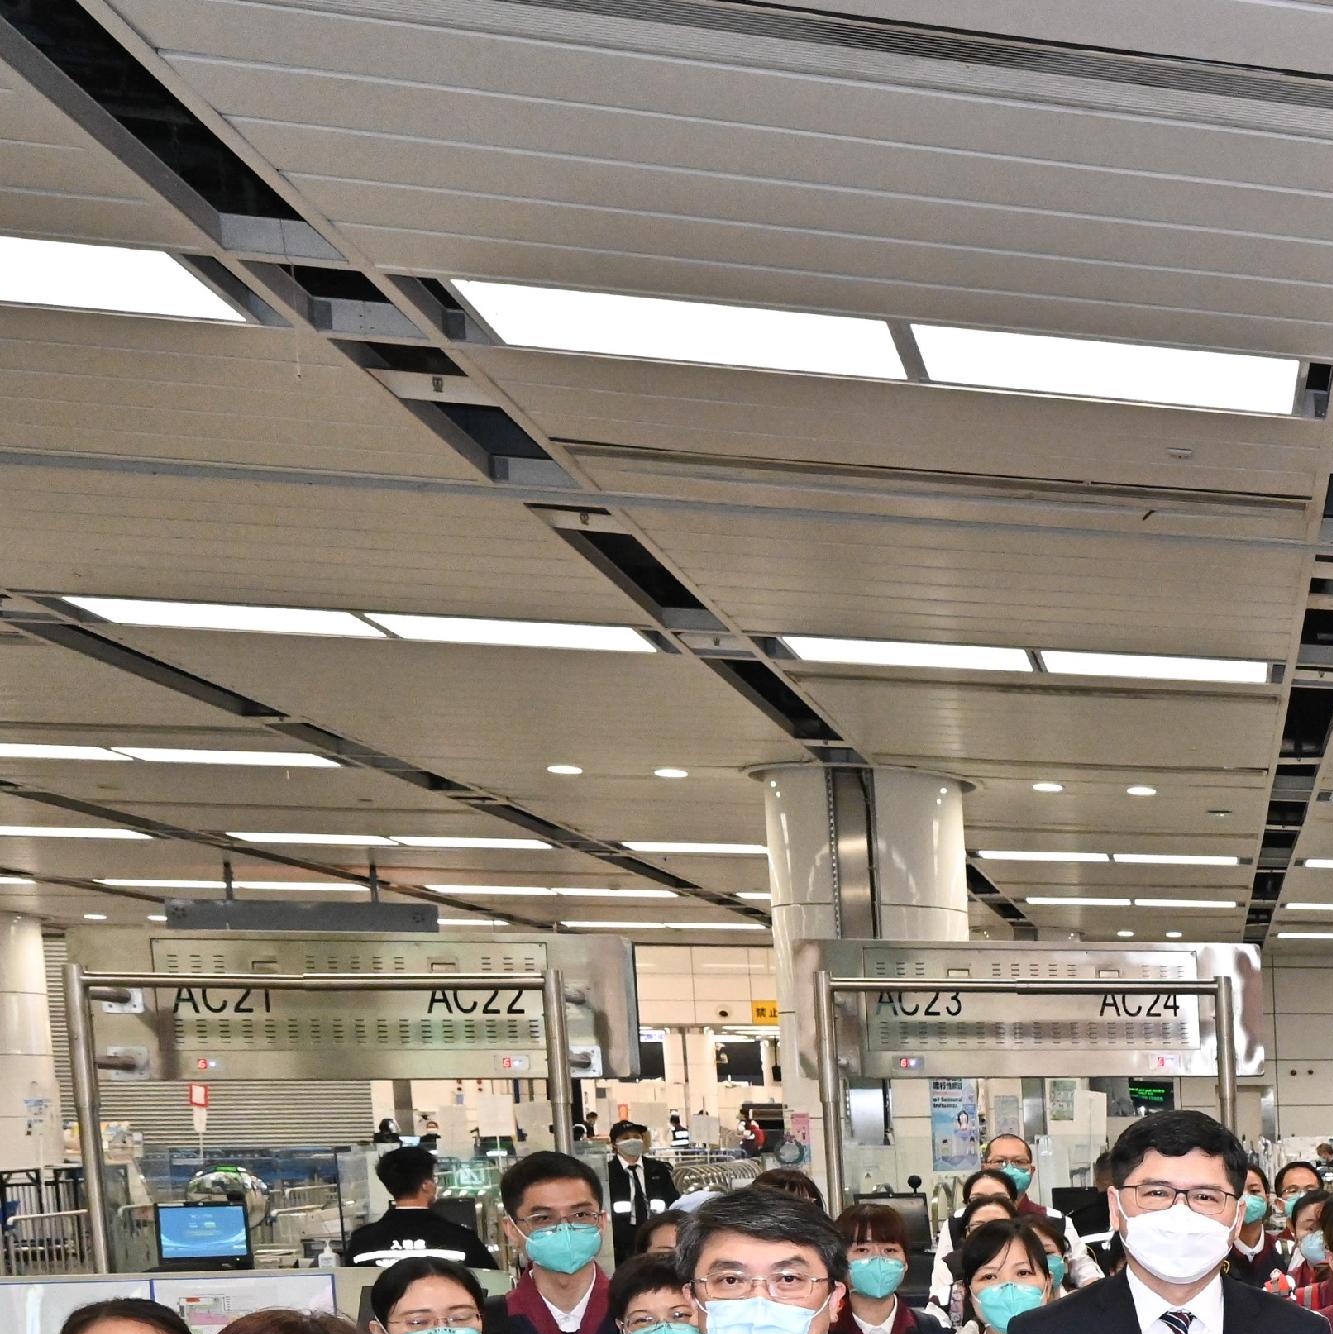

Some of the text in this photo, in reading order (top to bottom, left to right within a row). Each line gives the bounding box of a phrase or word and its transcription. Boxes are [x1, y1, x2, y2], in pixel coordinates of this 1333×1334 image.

[172, 986, 272, 1014] AC21
[427, 988, 525, 1015] AC22
[875, 991, 963, 1017] AC23
[1099, 992, 1181, 1018] AC24
